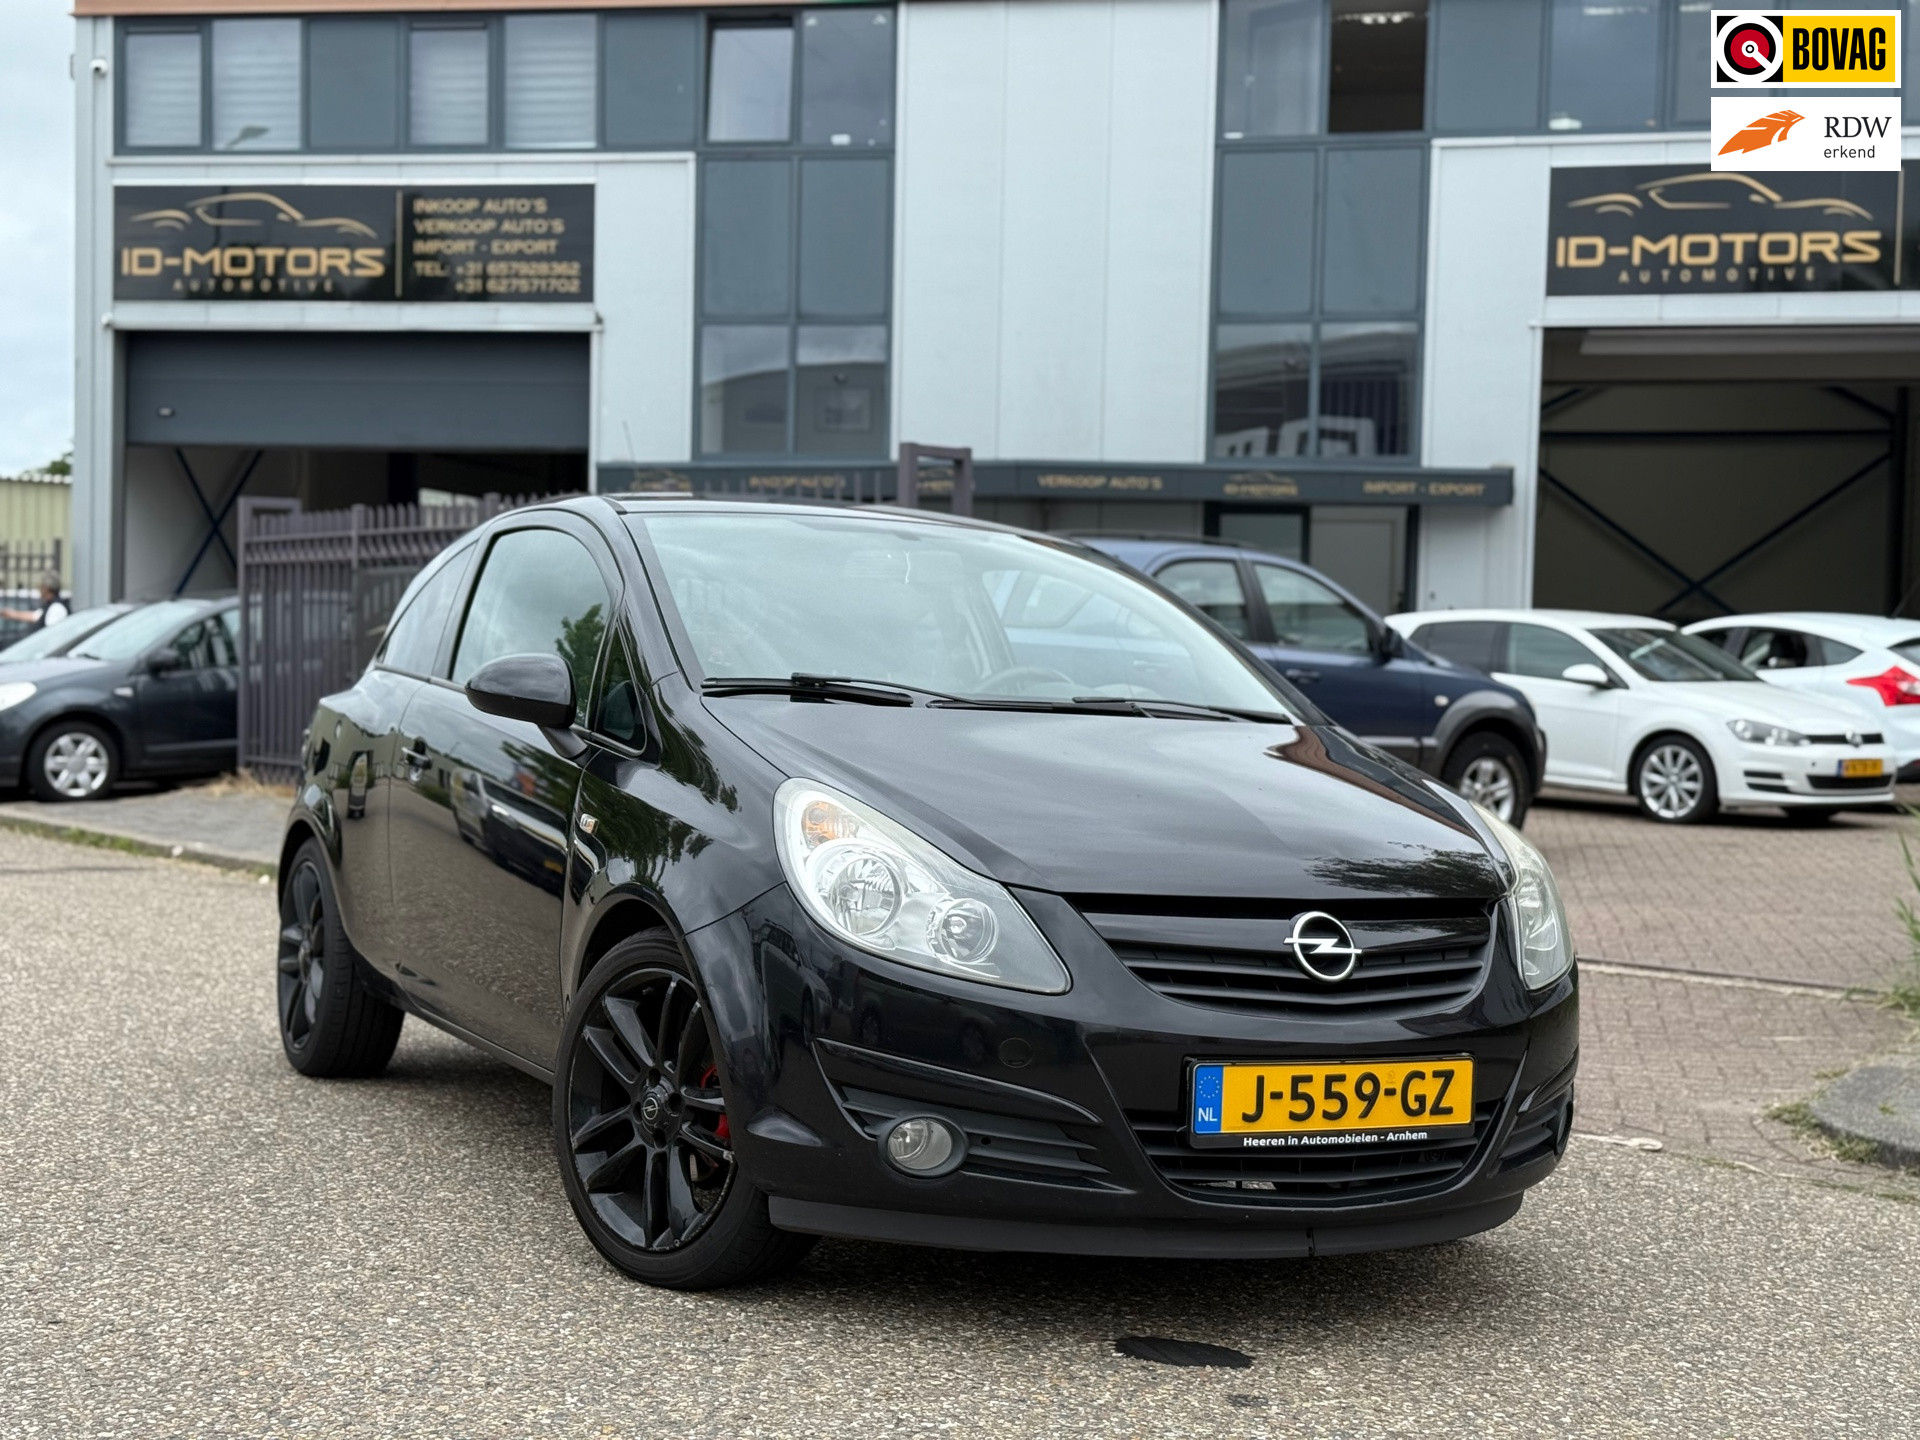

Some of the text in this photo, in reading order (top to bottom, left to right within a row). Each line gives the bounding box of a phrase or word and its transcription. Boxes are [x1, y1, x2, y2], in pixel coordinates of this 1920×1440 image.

[412, 197, 548, 214] INKOOP AUTO'S
[412, 217, 565, 235] VERKOOP AUTO'S
[412, 238, 477, 255] IMPORT
[490, 238, 559, 255] EXPORT
[1556, 230, 1882, 268] ID-MOTORS
[121, 246, 386, 277] ID-MOTORS
[1617, 268, 1816, 285] AUTOMOTIVE
[172, 278, 335, 293] AUTOMOTIVE
[1037, 475, 1106, 490] VERKOOP
[1363, 480, 1418, 496] IMPORT
[1429, 481, 1486, 497] EXPORT
[1198, 1069, 1455, 1123] NL J-559-GZ
[1243, 1136, 1285, 1147] Heeren
[1287, 1135, 1298, 1146] in
[1300, 1133, 1378, 1145] Automobielen
[1386, 1131, 1428, 1141] Arnhem
